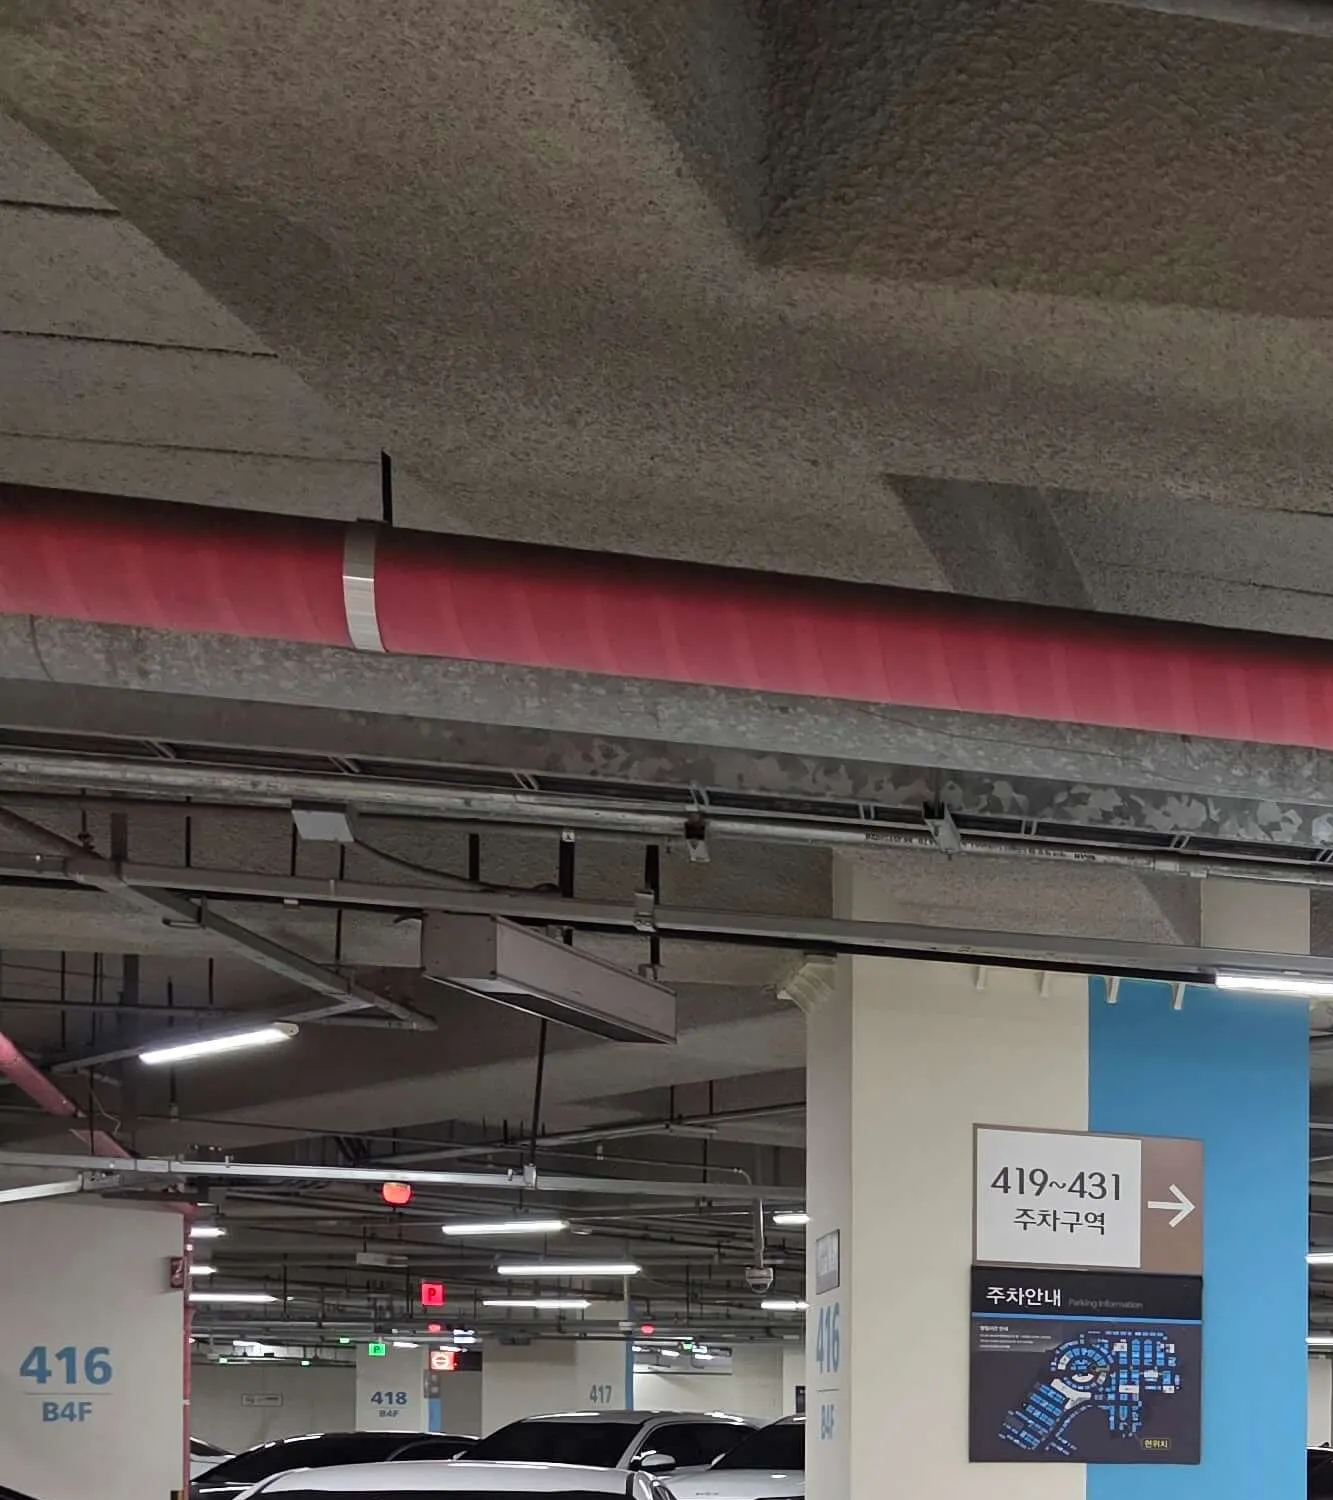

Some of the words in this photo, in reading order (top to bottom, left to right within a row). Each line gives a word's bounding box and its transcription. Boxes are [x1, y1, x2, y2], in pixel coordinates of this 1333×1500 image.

[990, 1167, 1121, 1201] 419~431
[1013, 1208, 1105, 1235] 주차구역
[986, 1287, 1062, 1307] 주차안내
[816, 1302, 840, 1375] 416
[19, 1345, 113, 1386] 416
[370, 1391, 407, 1405] 418
[590, 1384, 612, 1404] 417
[42, 1401, 93, 1422] B4F
